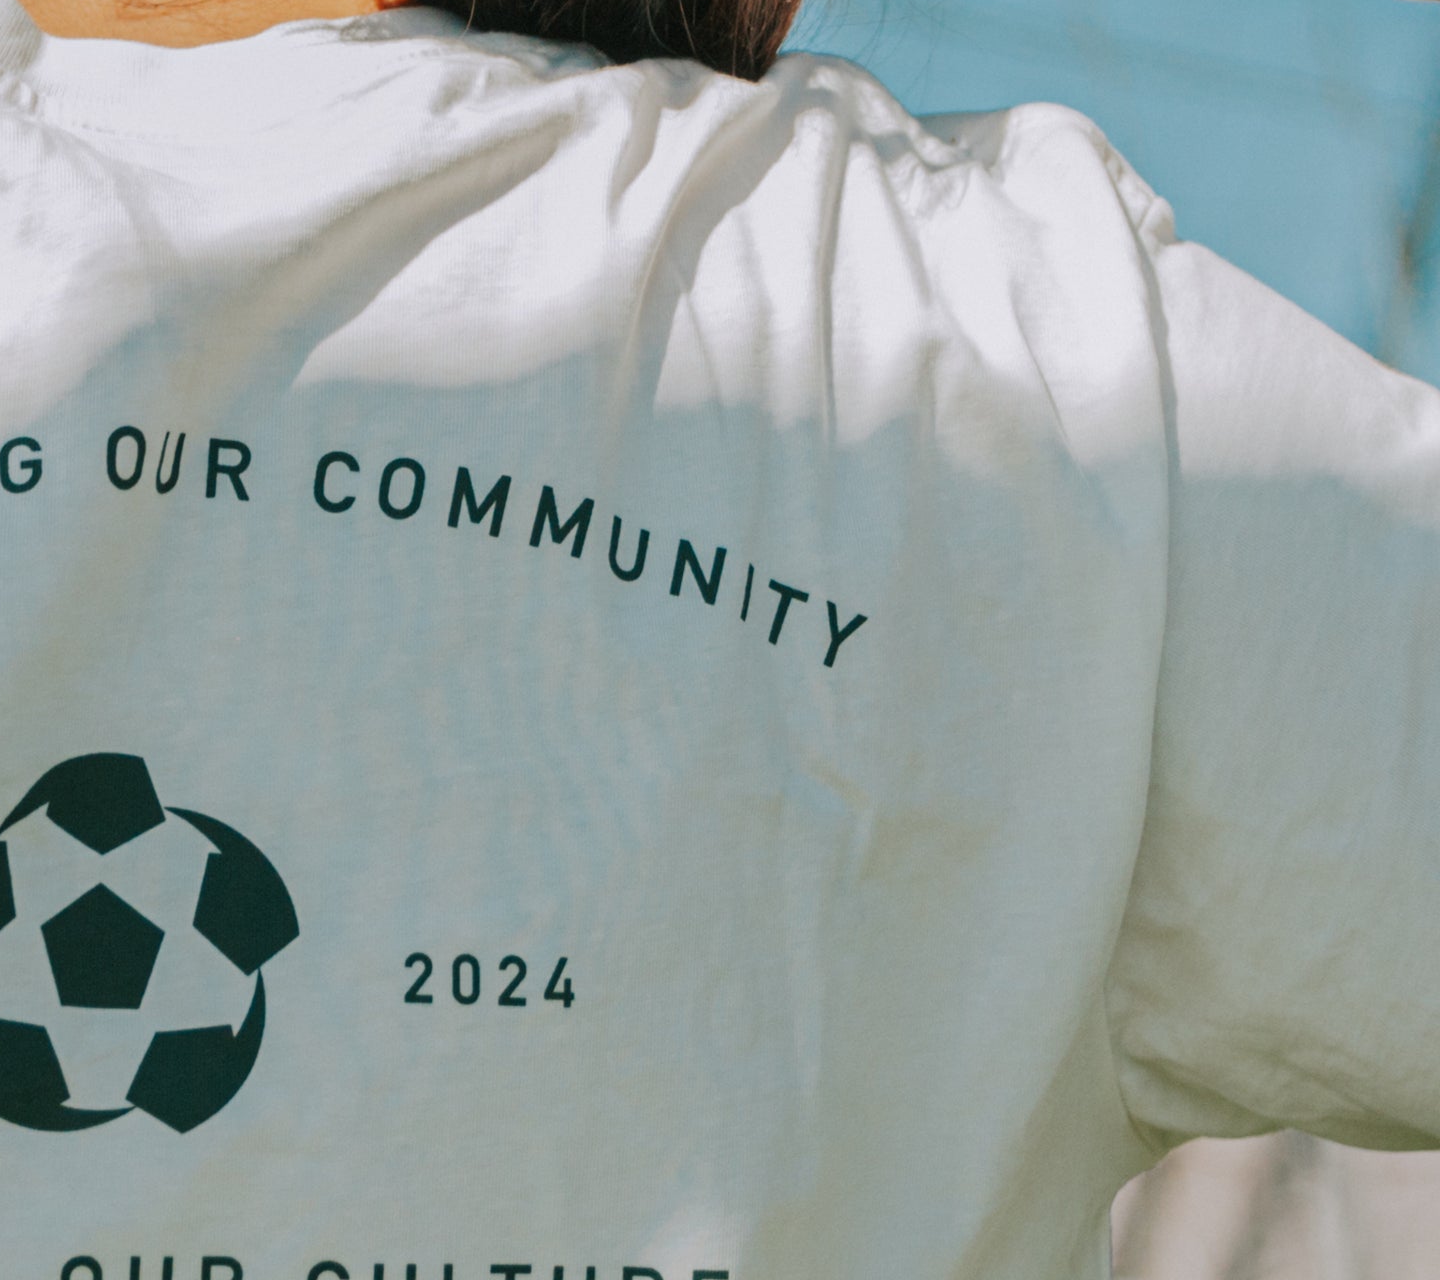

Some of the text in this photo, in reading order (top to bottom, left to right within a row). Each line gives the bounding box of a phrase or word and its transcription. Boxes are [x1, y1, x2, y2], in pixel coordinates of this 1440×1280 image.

[104, 423, 254, 503] OUR
[311, 449, 870, 669] COMMUNITY
[402, 950, 577, 1011] 2024
